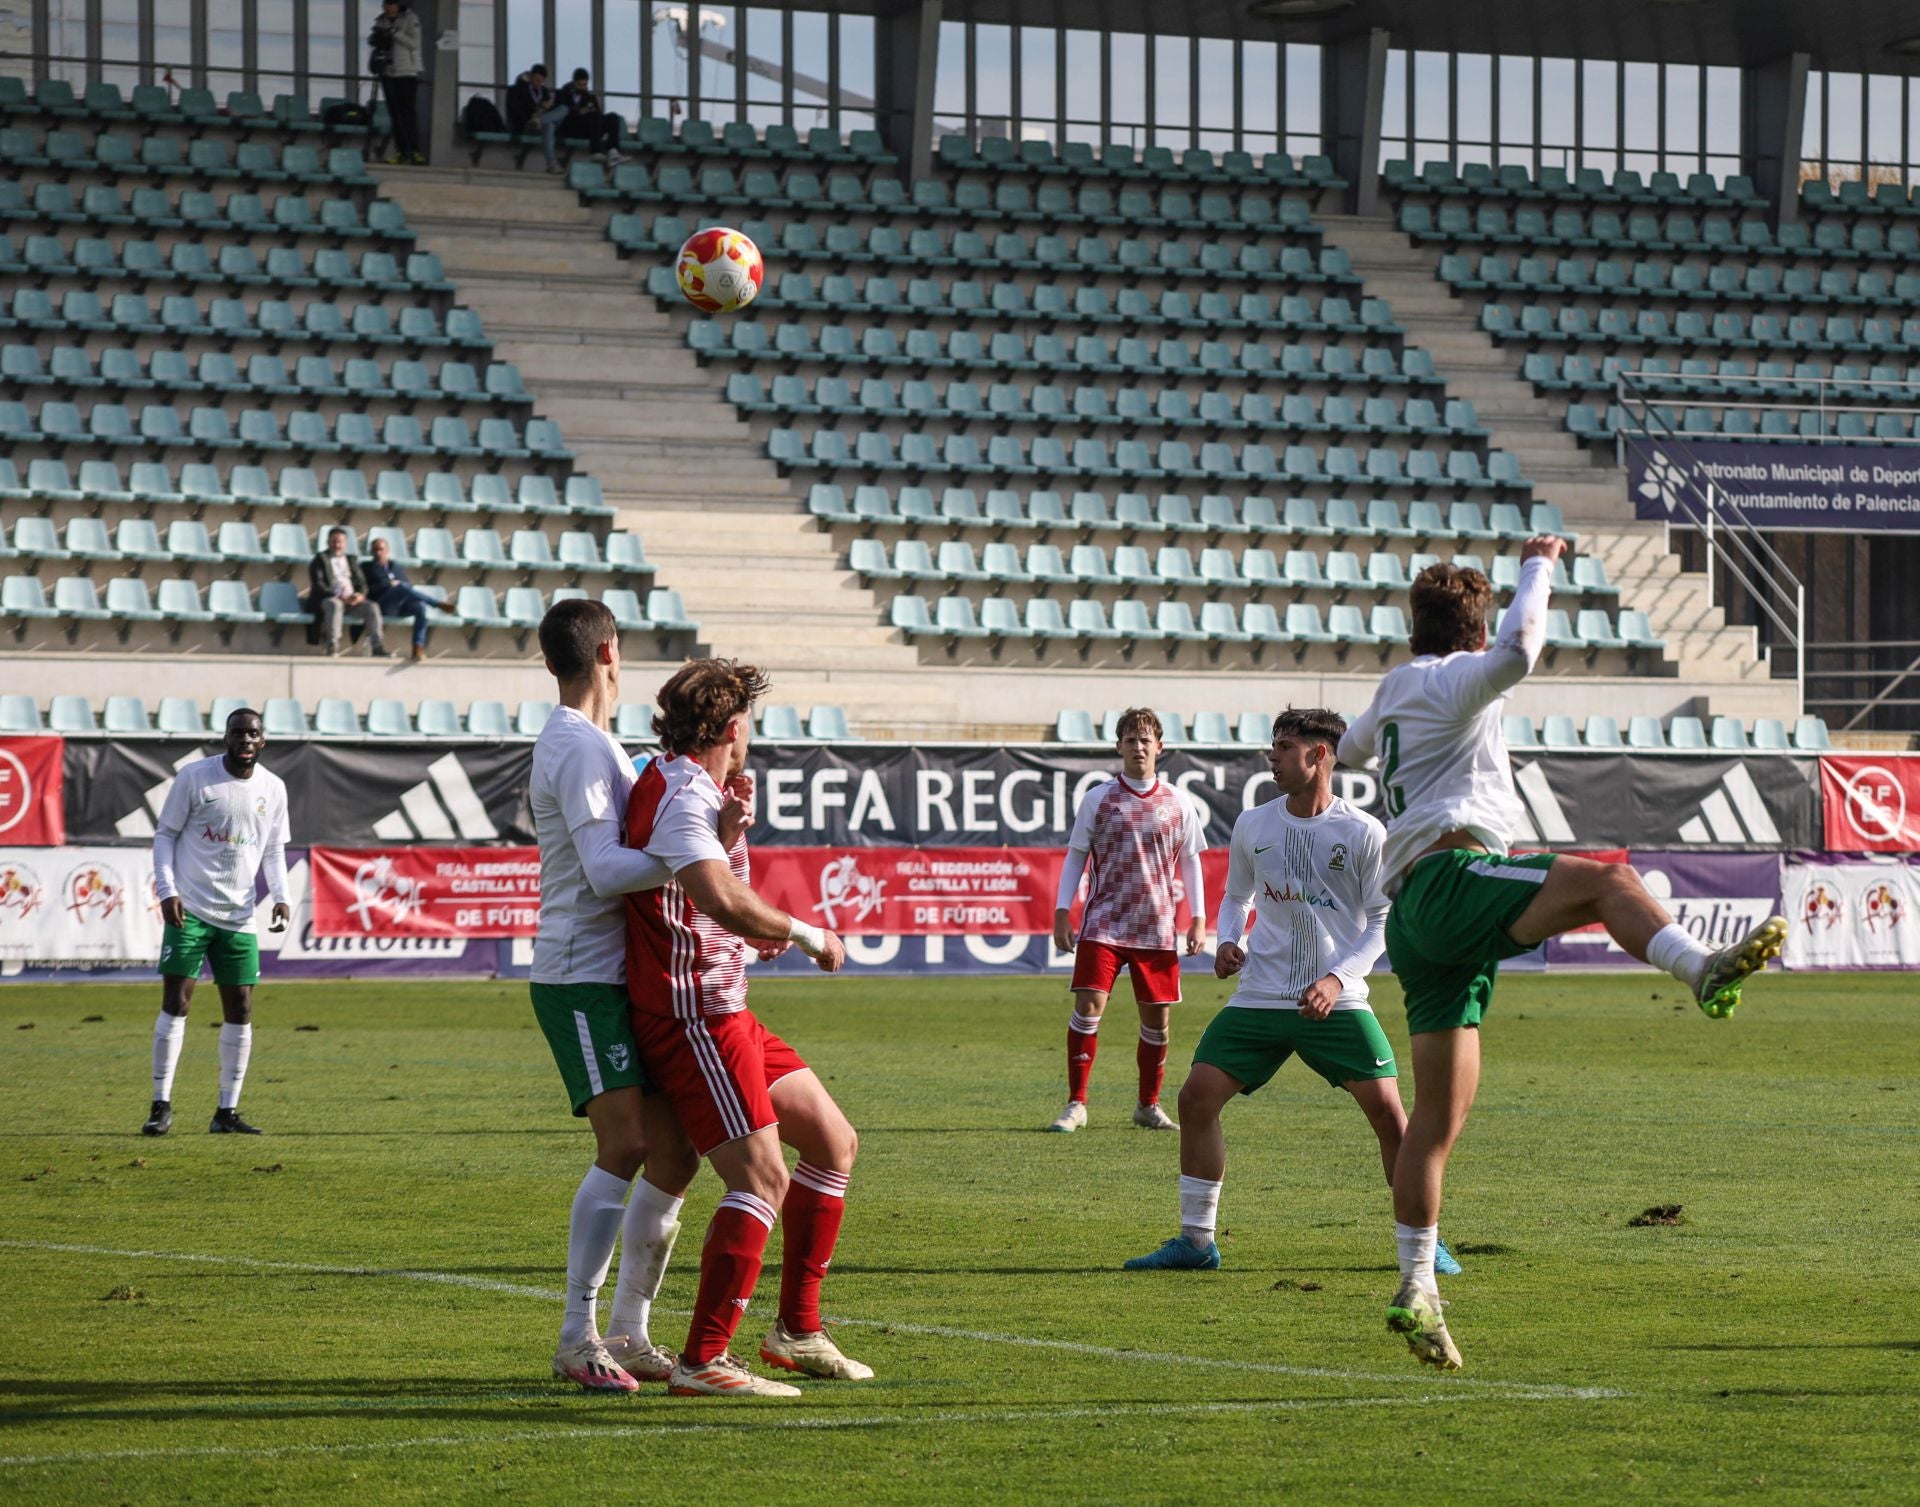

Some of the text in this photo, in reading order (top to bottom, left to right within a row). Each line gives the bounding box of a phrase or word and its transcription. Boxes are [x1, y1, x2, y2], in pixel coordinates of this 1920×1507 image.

[1771, 463, 1844, 485] Municipal
[1850, 467, 1868, 483] de
[1719, 490, 1920, 512] Ayuntamiento de Palencia
[916, 766, 1226, 833] REGIS'
[896, 862, 928, 875] REAL
[451, 879, 515, 893] CASTILLA
[517, 879, 528, 892] Y
[909, 876, 1018, 892] CASTILLA Y LEÓN
[455, 908, 483, 927] DE
[914, 903, 1011, 924] DE FÚTBOL
